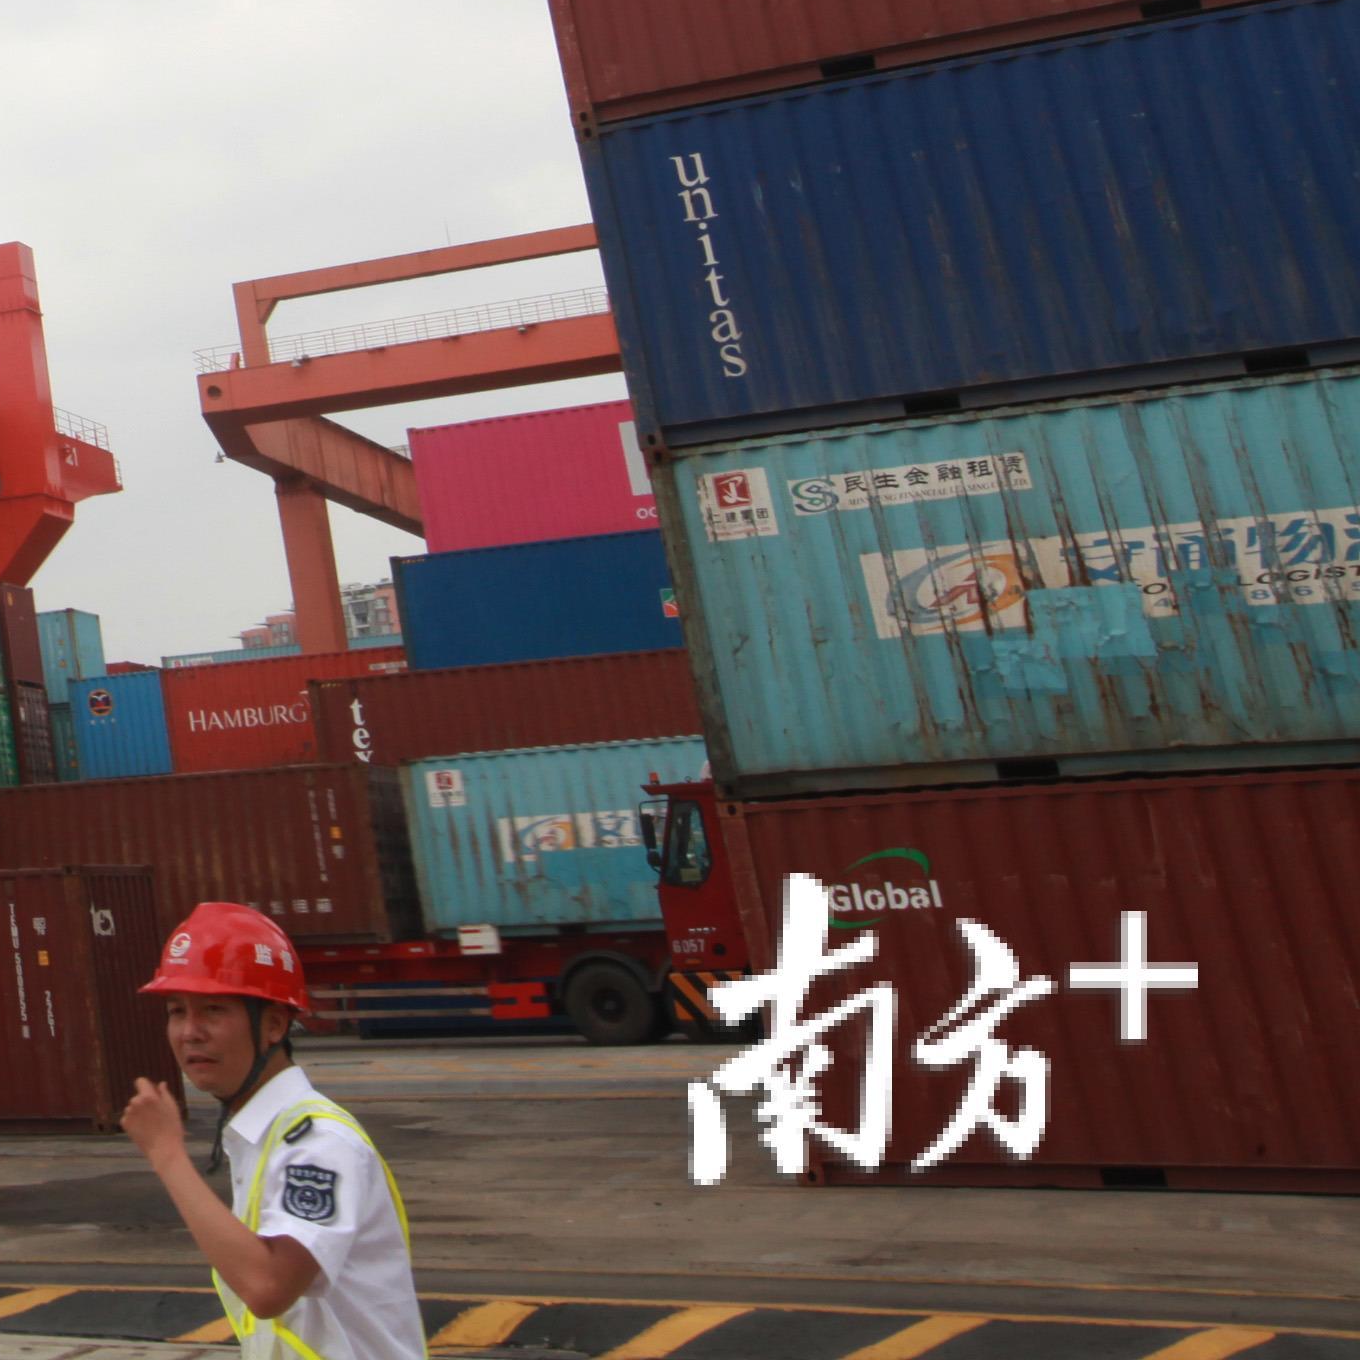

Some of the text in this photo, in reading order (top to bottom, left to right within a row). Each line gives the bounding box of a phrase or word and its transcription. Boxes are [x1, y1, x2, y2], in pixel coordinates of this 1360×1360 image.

[668, 152, 748, 378] unitas
[843, 454, 1024, 494] 民生金融租赁
[188, 703, 308, 733] HAMBURG
[828, 879, 943, 913] Global
